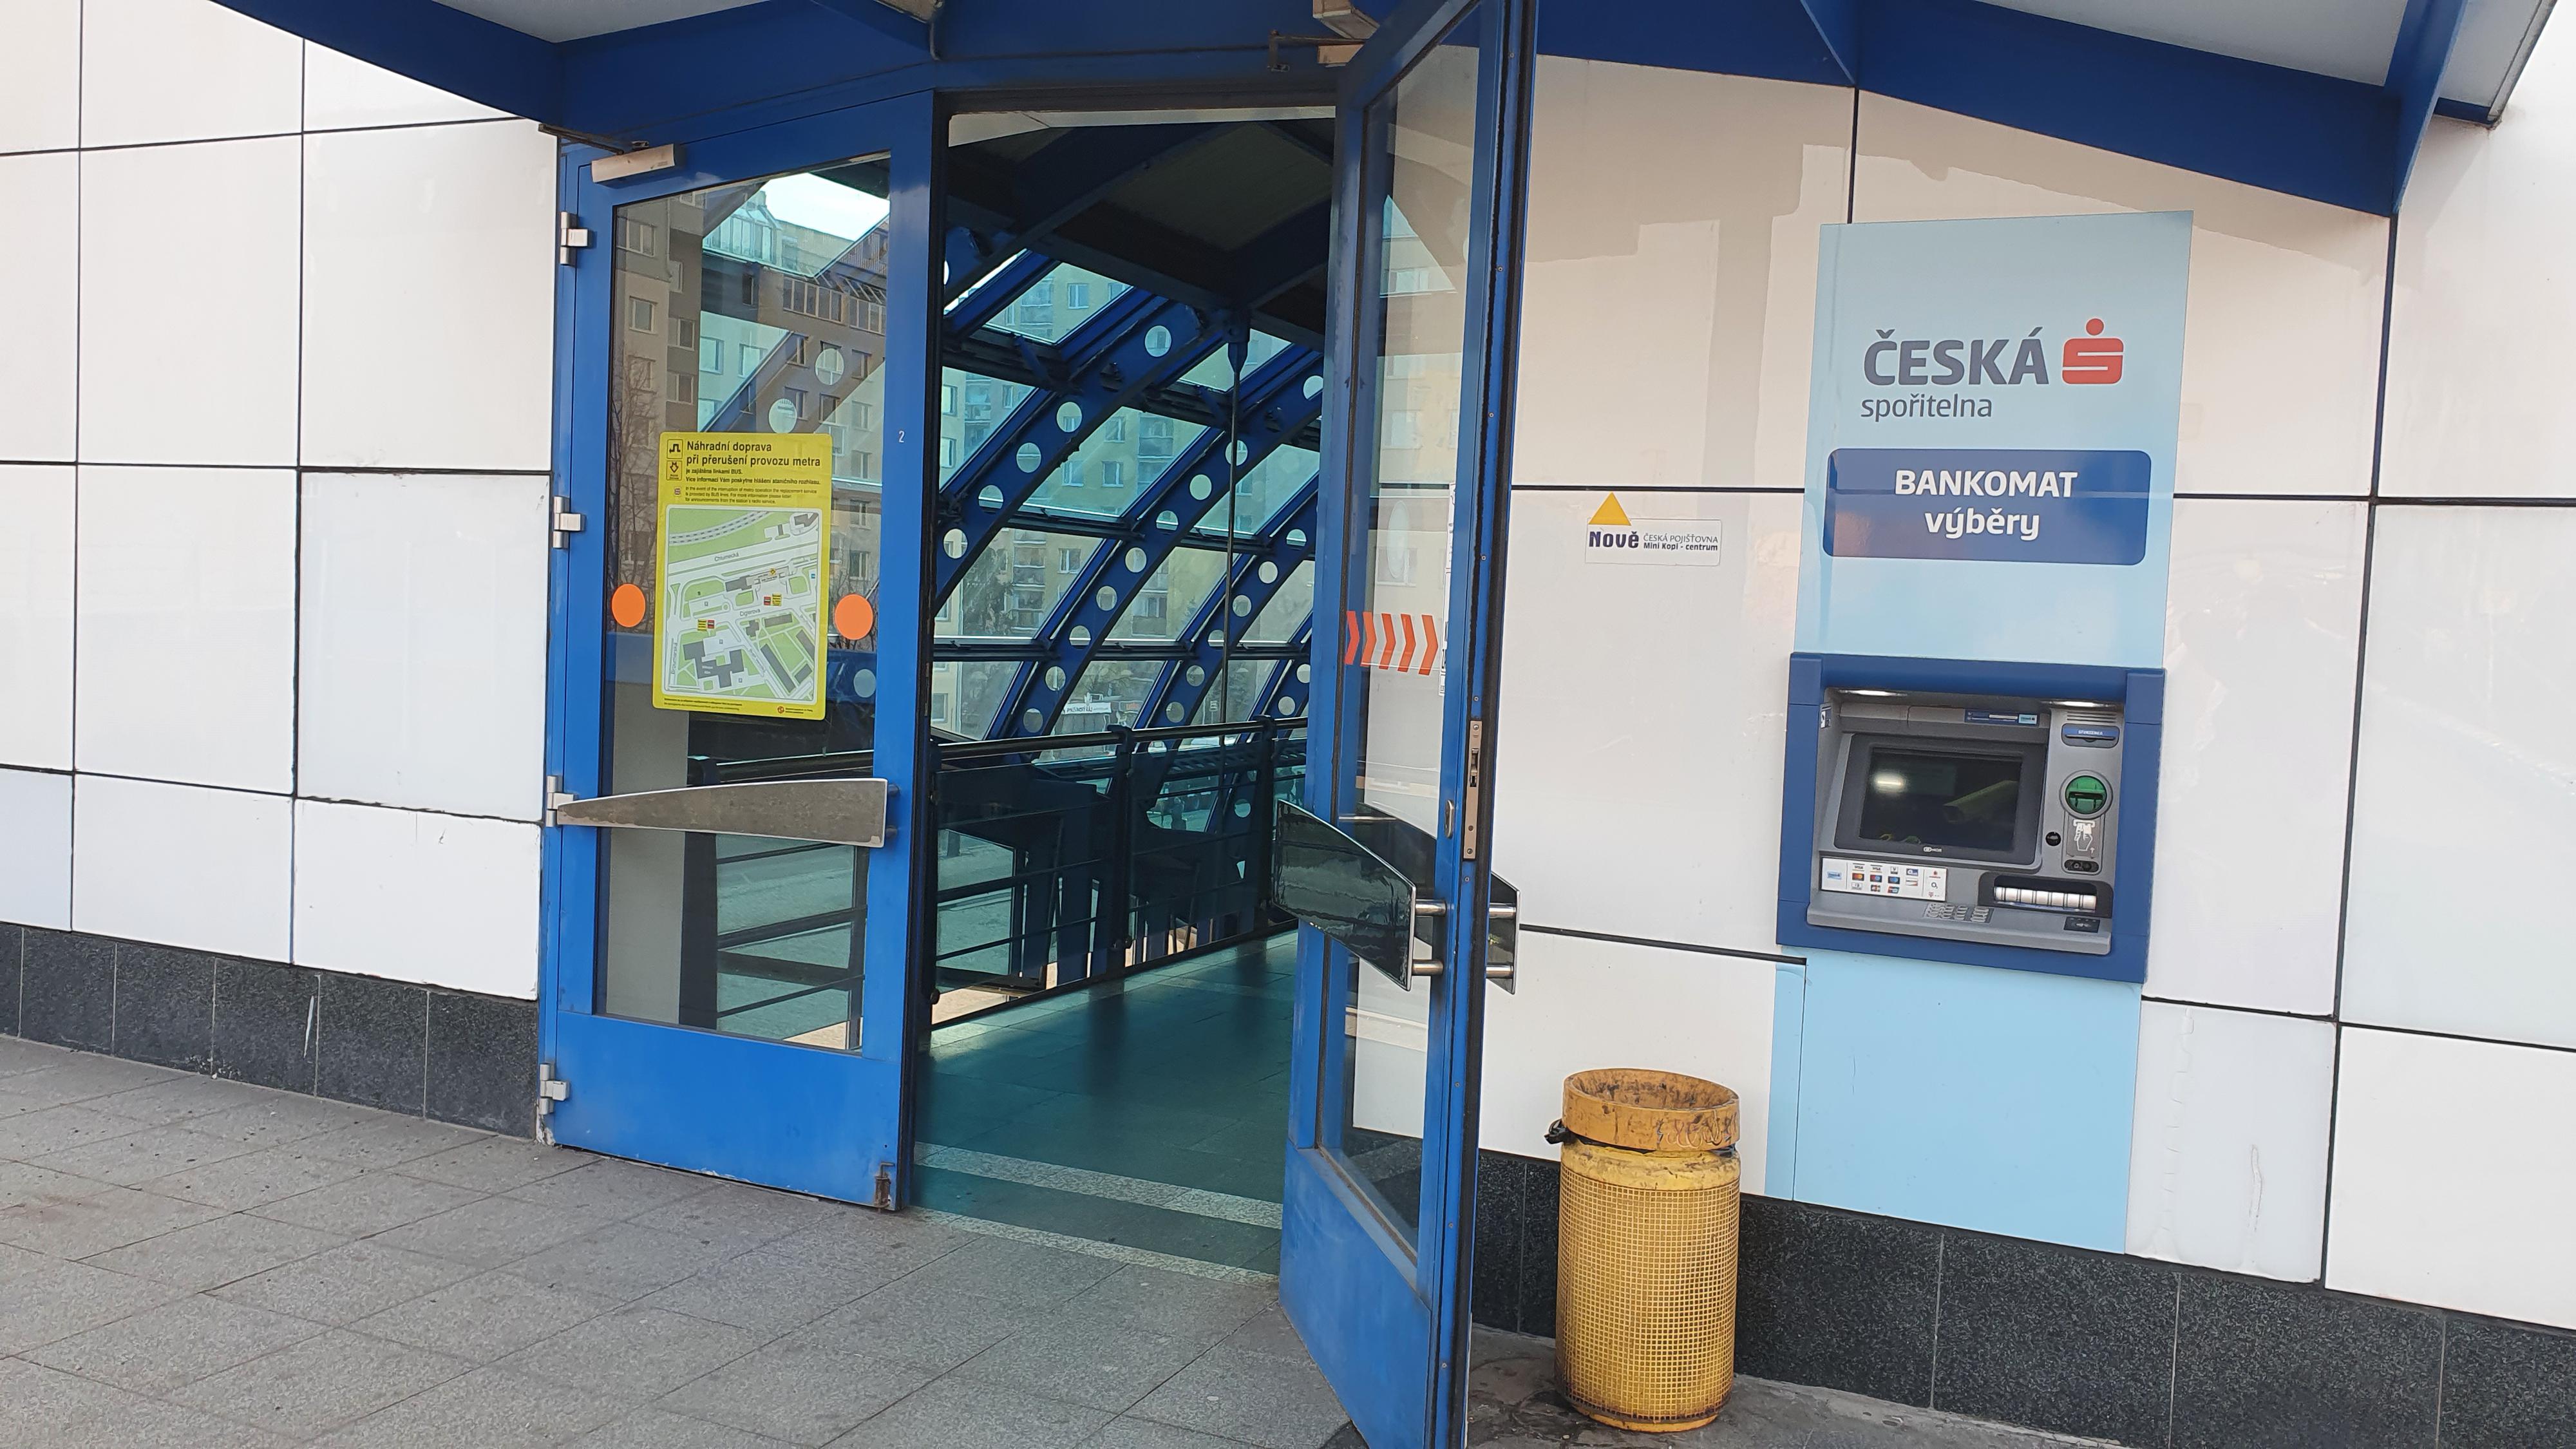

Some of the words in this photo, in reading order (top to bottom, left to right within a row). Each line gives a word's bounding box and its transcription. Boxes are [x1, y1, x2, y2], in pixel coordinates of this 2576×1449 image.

[1863, 327, 2050, 386] ČESKÁ
[1860, 393, 1993, 422] spořitelna
[898, 430, 905, 444] 2
[687, 440, 730, 451] Náhradní
[733, 442, 772, 454] doprava
[687, 454, 699, 466] při
[702, 454, 748, 467] přerušení
[750, 457, 790, 468] provozu
[793, 457, 821, 466] metra
[1894, 469, 2078, 498] BANKOMAT
[1924, 507, 2040, 541] výběry
[1588, 530, 1640, 549] Nově
[1643, 533, 1669, 543] ČESKÁ
[1669, 534, 1719, 544] POJIŠŤOVNA
